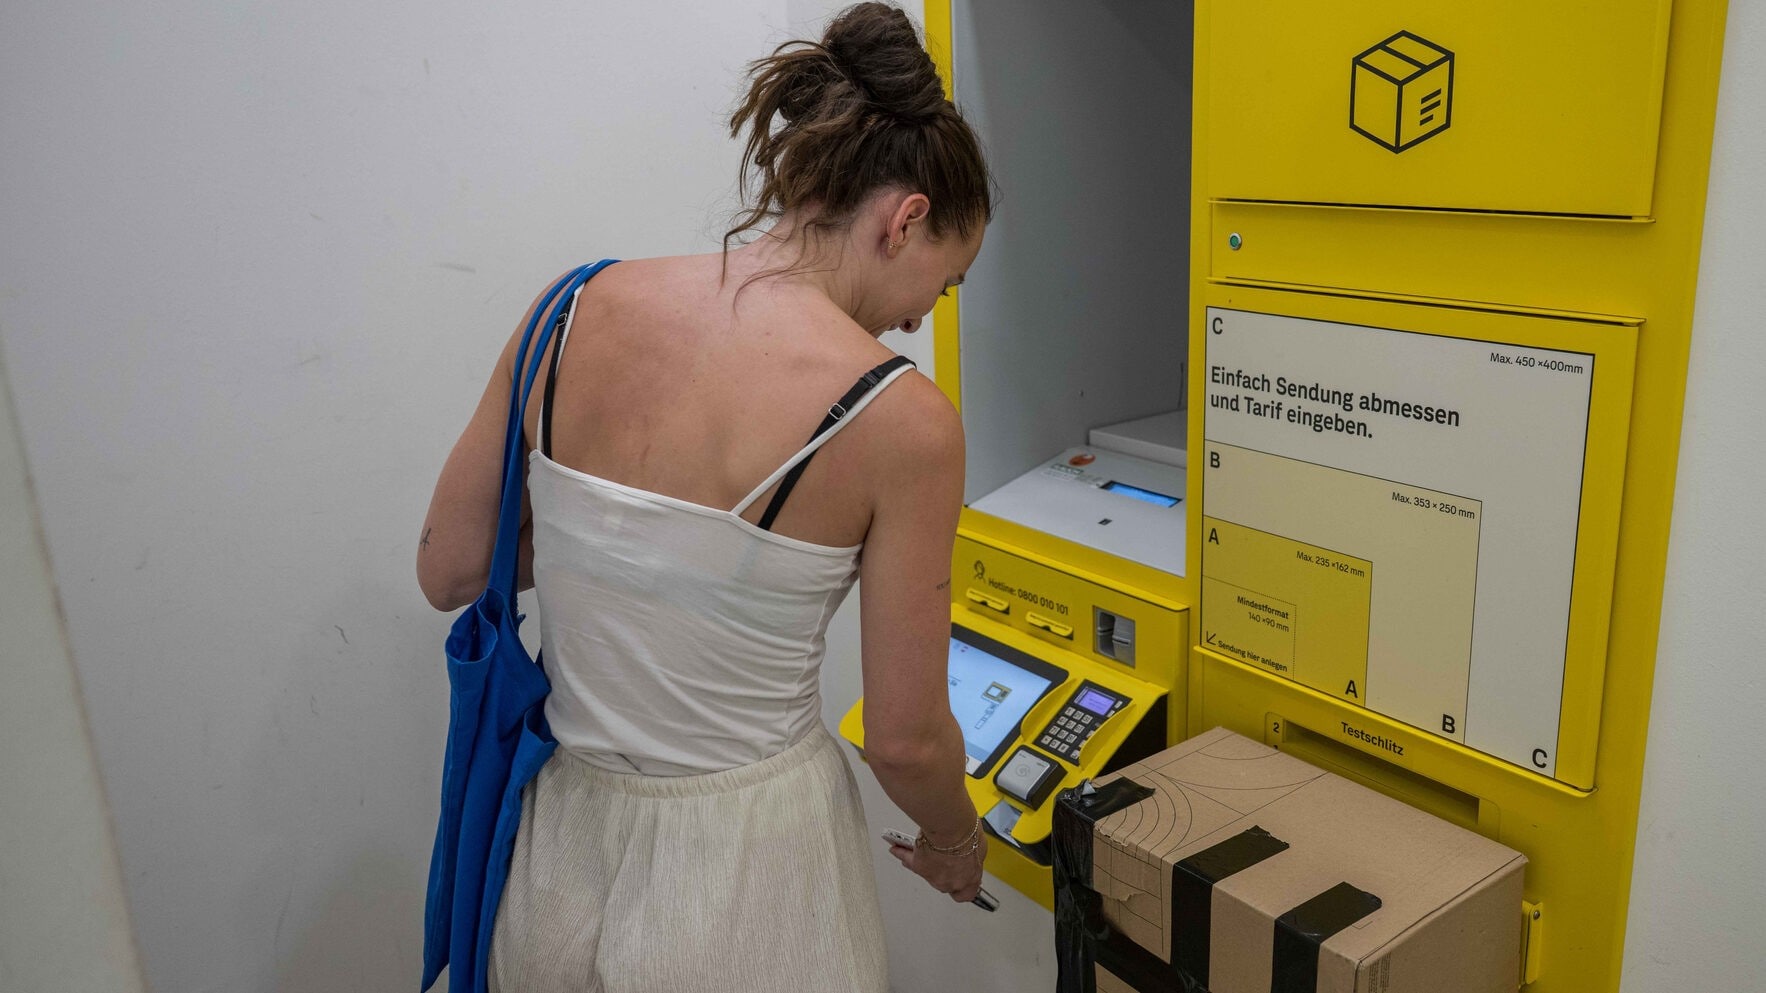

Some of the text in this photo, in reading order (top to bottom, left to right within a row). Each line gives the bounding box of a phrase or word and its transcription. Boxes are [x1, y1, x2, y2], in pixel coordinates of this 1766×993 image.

[1212, 317, 1223, 335] C
[1490, 352, 1513, 365] Max.
[1515, 355, 1535, 368] 450
[1211, 366, 1460, 427] Einfach Sendung abmessen
[1210, 393, 1373, 438] und Tarif eingeben.
[1210, 452, 1220, 468] B
[1392, 492, 1412, 504] Max.
[1414, 497, 1430, 509] 353
[1439, 502, 1457, 515] 250
[1458, 508, 1475, 519] mm
[1208, 528, 1220, 545] A
[1296, 551, 1314, 563] Max.
[1316, 557, 1330, 568] 235
[1350, 568, 1365, 578] mm
[1018, 588, 1038, 604] 0800
[1040, 597, 1054, 610] 010
[1056, 602, 1069, 616] 101
[1237, 596, 1289, 620] Mindestformat
[1248, 612, 1260, 622] 140
[1276, 624, 1290, 632] mm
[1218, 640, 1288, 672] Sendung hier anlegen
[1344, 680, 1358, 698] A
[1272, 722, 1280, 734] 2
[1442, 713, 1456, 734] B
[1341, 721, 1404, 756] Testschlitz
[1532, 748, 1548, 769] C
